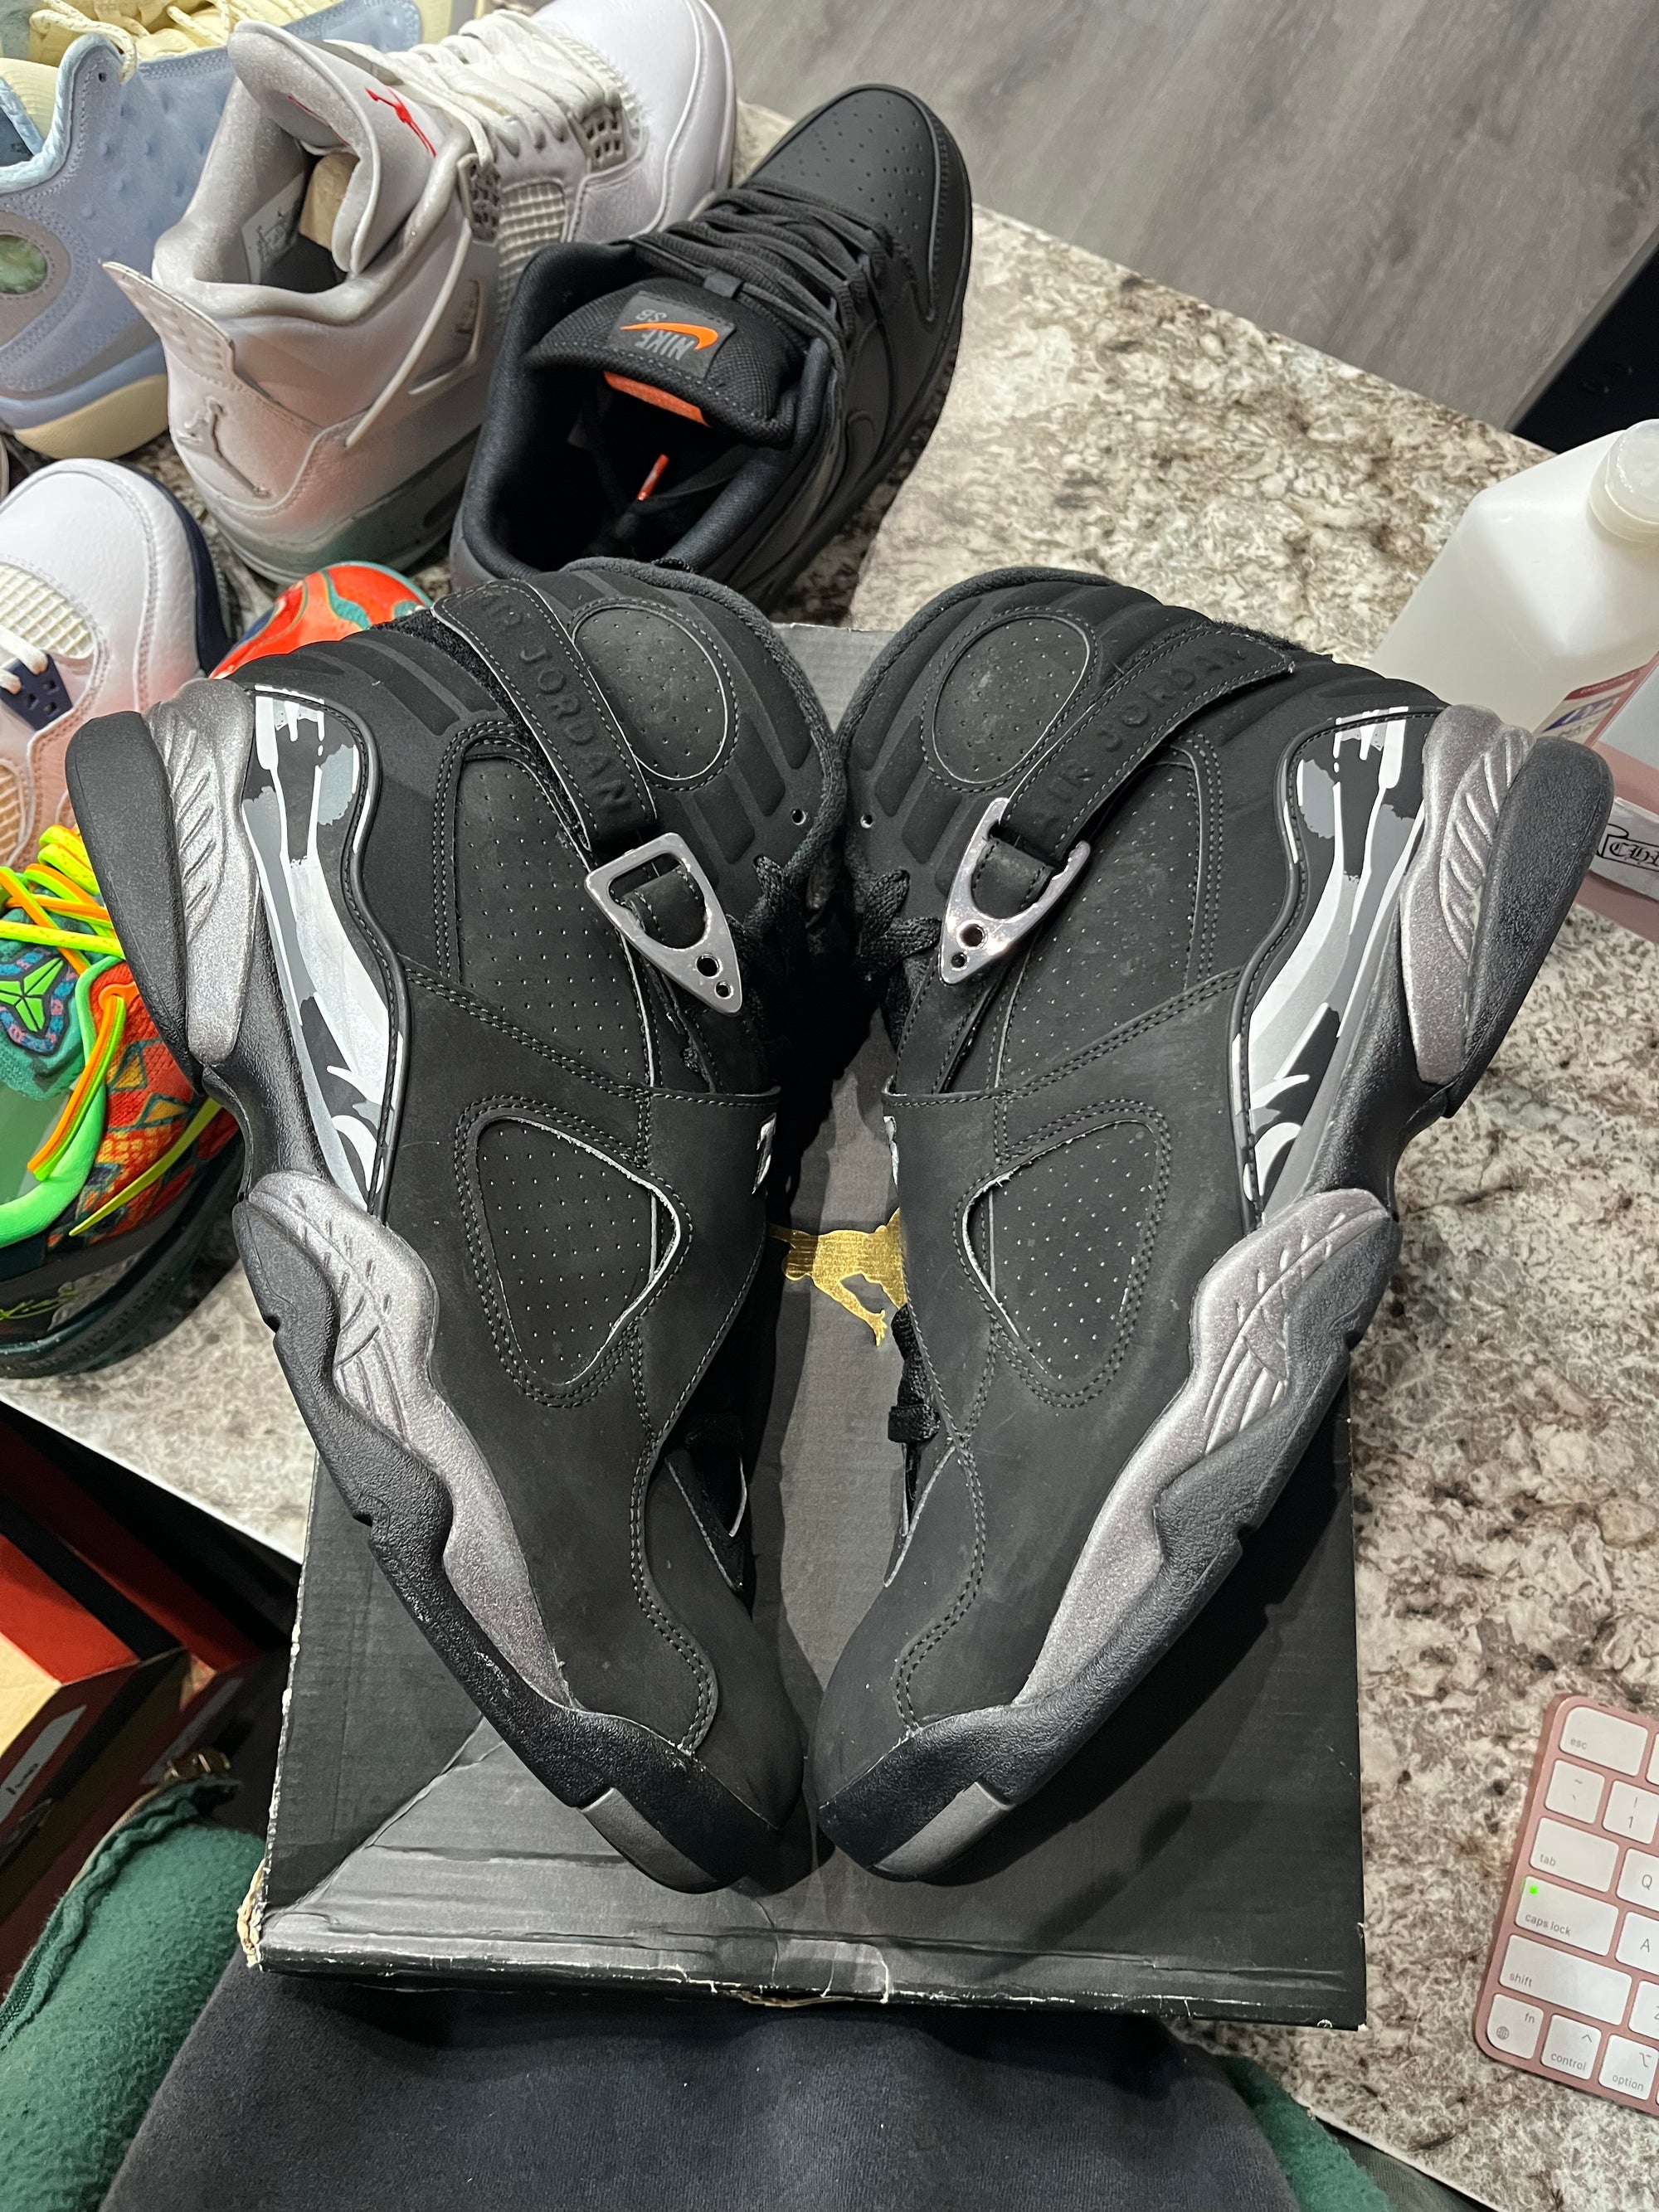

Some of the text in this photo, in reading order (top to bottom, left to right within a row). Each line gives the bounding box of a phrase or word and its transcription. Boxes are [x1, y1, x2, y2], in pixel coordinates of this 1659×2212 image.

[635, 309, 668, 323] SB
[635, 328, 696, 361] NIKE
[1096, 648, 1244, 753] JORDAN
[519, 646, 634, 812] JORDAN
[1570, 1738, 1588, 1750] esc
[1627, 1816, 1634, 1829] 1
[1540, 1853, 1556, 1867] tab
[1642, 1874, 1652, 1891] Q
[1525, 1913, 1571, 1937] caps lock
[1639, 1938, 1651, 1952] A
[1509, 1971, 1533, 1987] shift
[1525, 2012, 1535, 2025] fn
[1550, 2051, 1587, 2072] control
[1612, 2074, 1644, 2092] option
